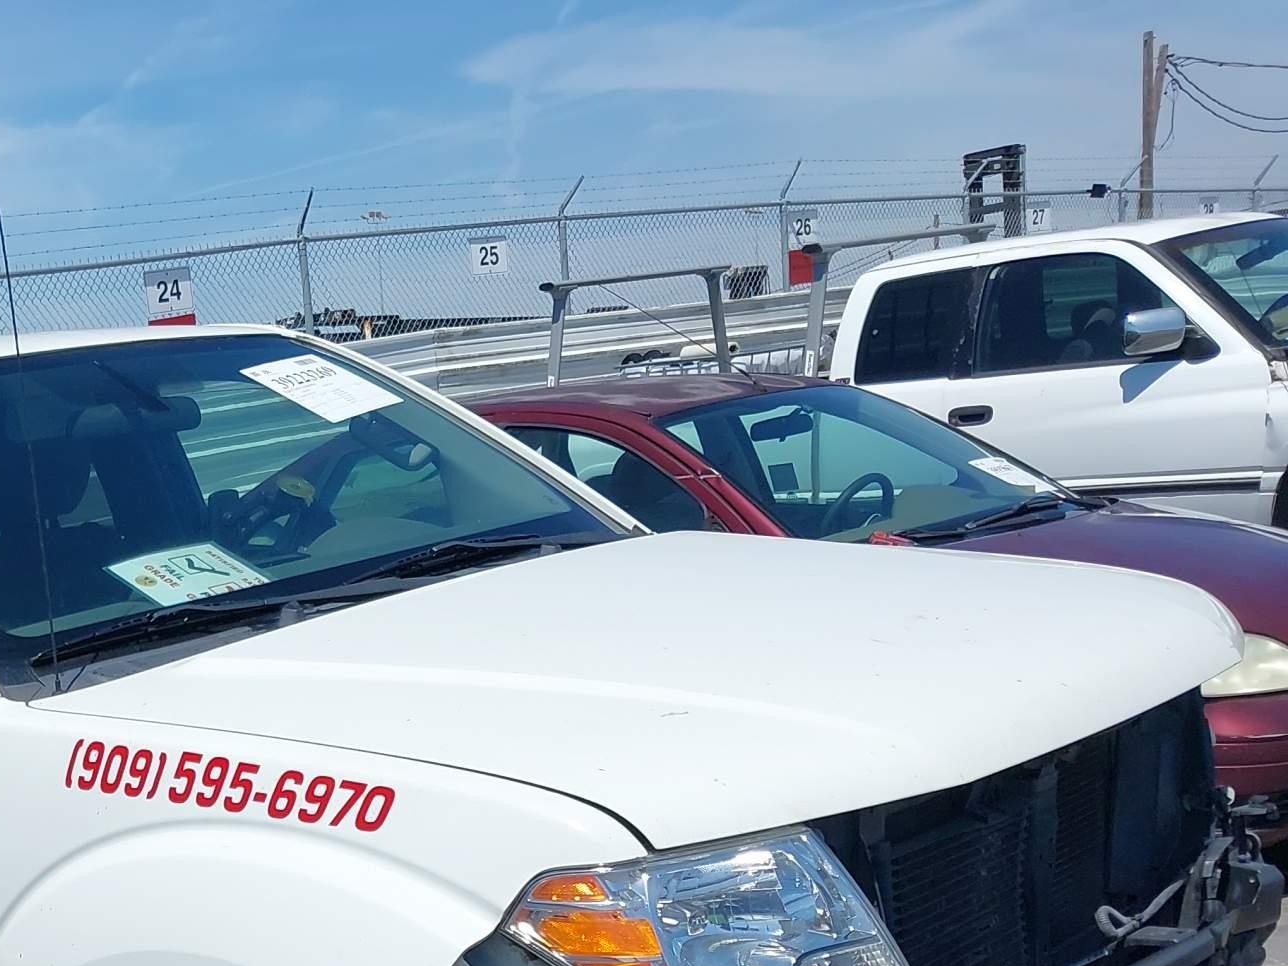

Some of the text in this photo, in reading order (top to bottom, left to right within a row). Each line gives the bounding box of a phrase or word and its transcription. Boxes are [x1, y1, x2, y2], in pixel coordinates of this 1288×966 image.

[795, 218, 812, 236] 26
[1032, 208, 1045, 225] 27
[479, 245, 499, 266] 25
[157, 279, 182, 303] 24
[271, 365, 337, 390] 39223269
[143, 564, 180, 589] GRADE
[65, 738, 396, 833] (909) 595-6970
